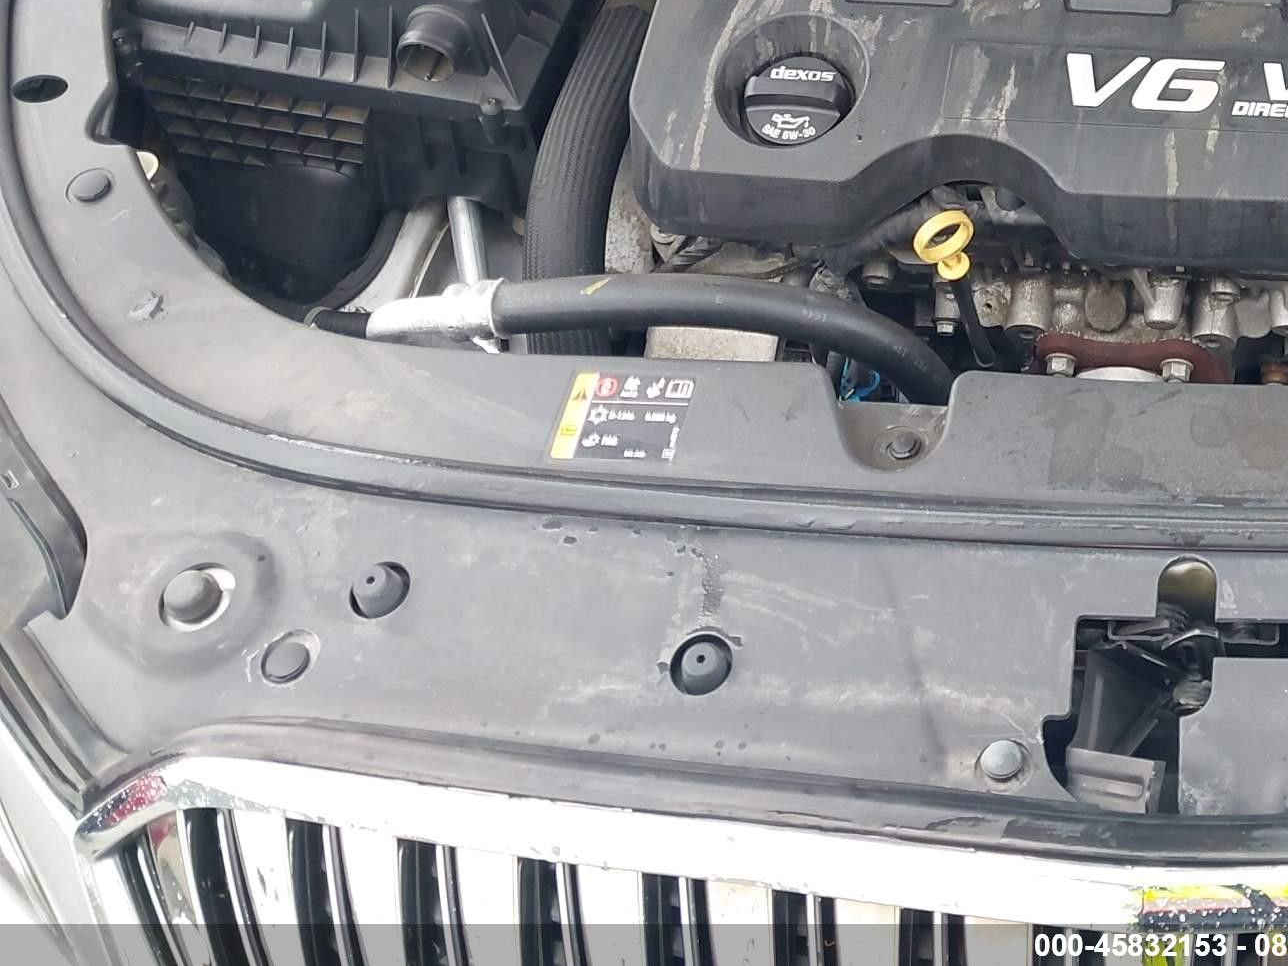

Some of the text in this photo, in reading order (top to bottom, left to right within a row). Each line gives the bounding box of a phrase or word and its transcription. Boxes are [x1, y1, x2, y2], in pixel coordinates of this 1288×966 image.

[770, 65, 838, 82] dexos
[1066, 52, 1226, 113] V6
[761, 123, 781, 139] SAE
